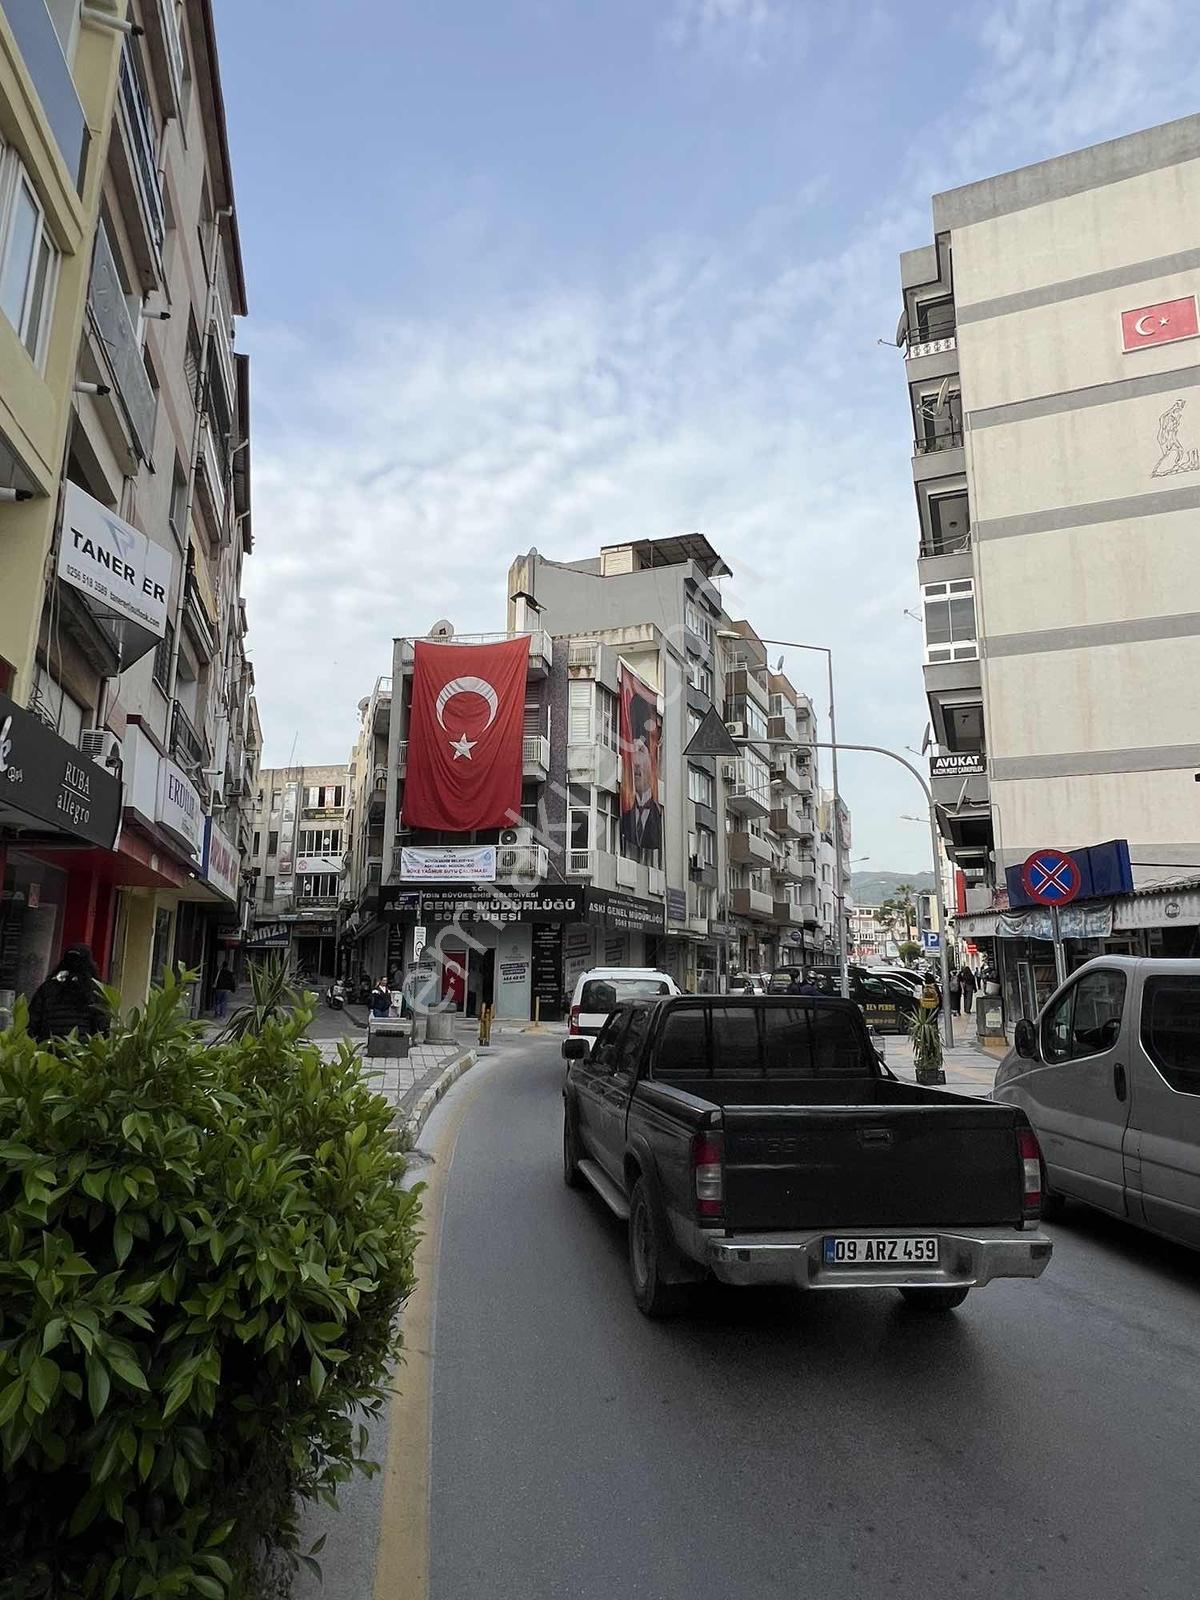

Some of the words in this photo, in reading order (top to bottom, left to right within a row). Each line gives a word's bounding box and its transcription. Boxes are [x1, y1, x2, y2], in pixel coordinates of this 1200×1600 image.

[70, 526, 136, 587] TANER
[142, 574, 166, 604] ER
[935, 755, 980, 768] AVUKAT
[64, 761, 91, 795] RUBA
[56, 790, 91, 825] allegro
[423, 901, 474, 910] GENEL
[476, 898, 576, 910] MÜDÜRLÜĞÜ
[588, 902, 606, 914] ASKİ
[606, 905, 628, 918] GENEL
[472, 911, 521, 922] ŞUBESİ
[927, 933, 938, 946] P
[835, 1240, 858, 1261] 09
[865, 1240, 898, 1260] ARZ
[903, 1239, 936, 1260] 459
